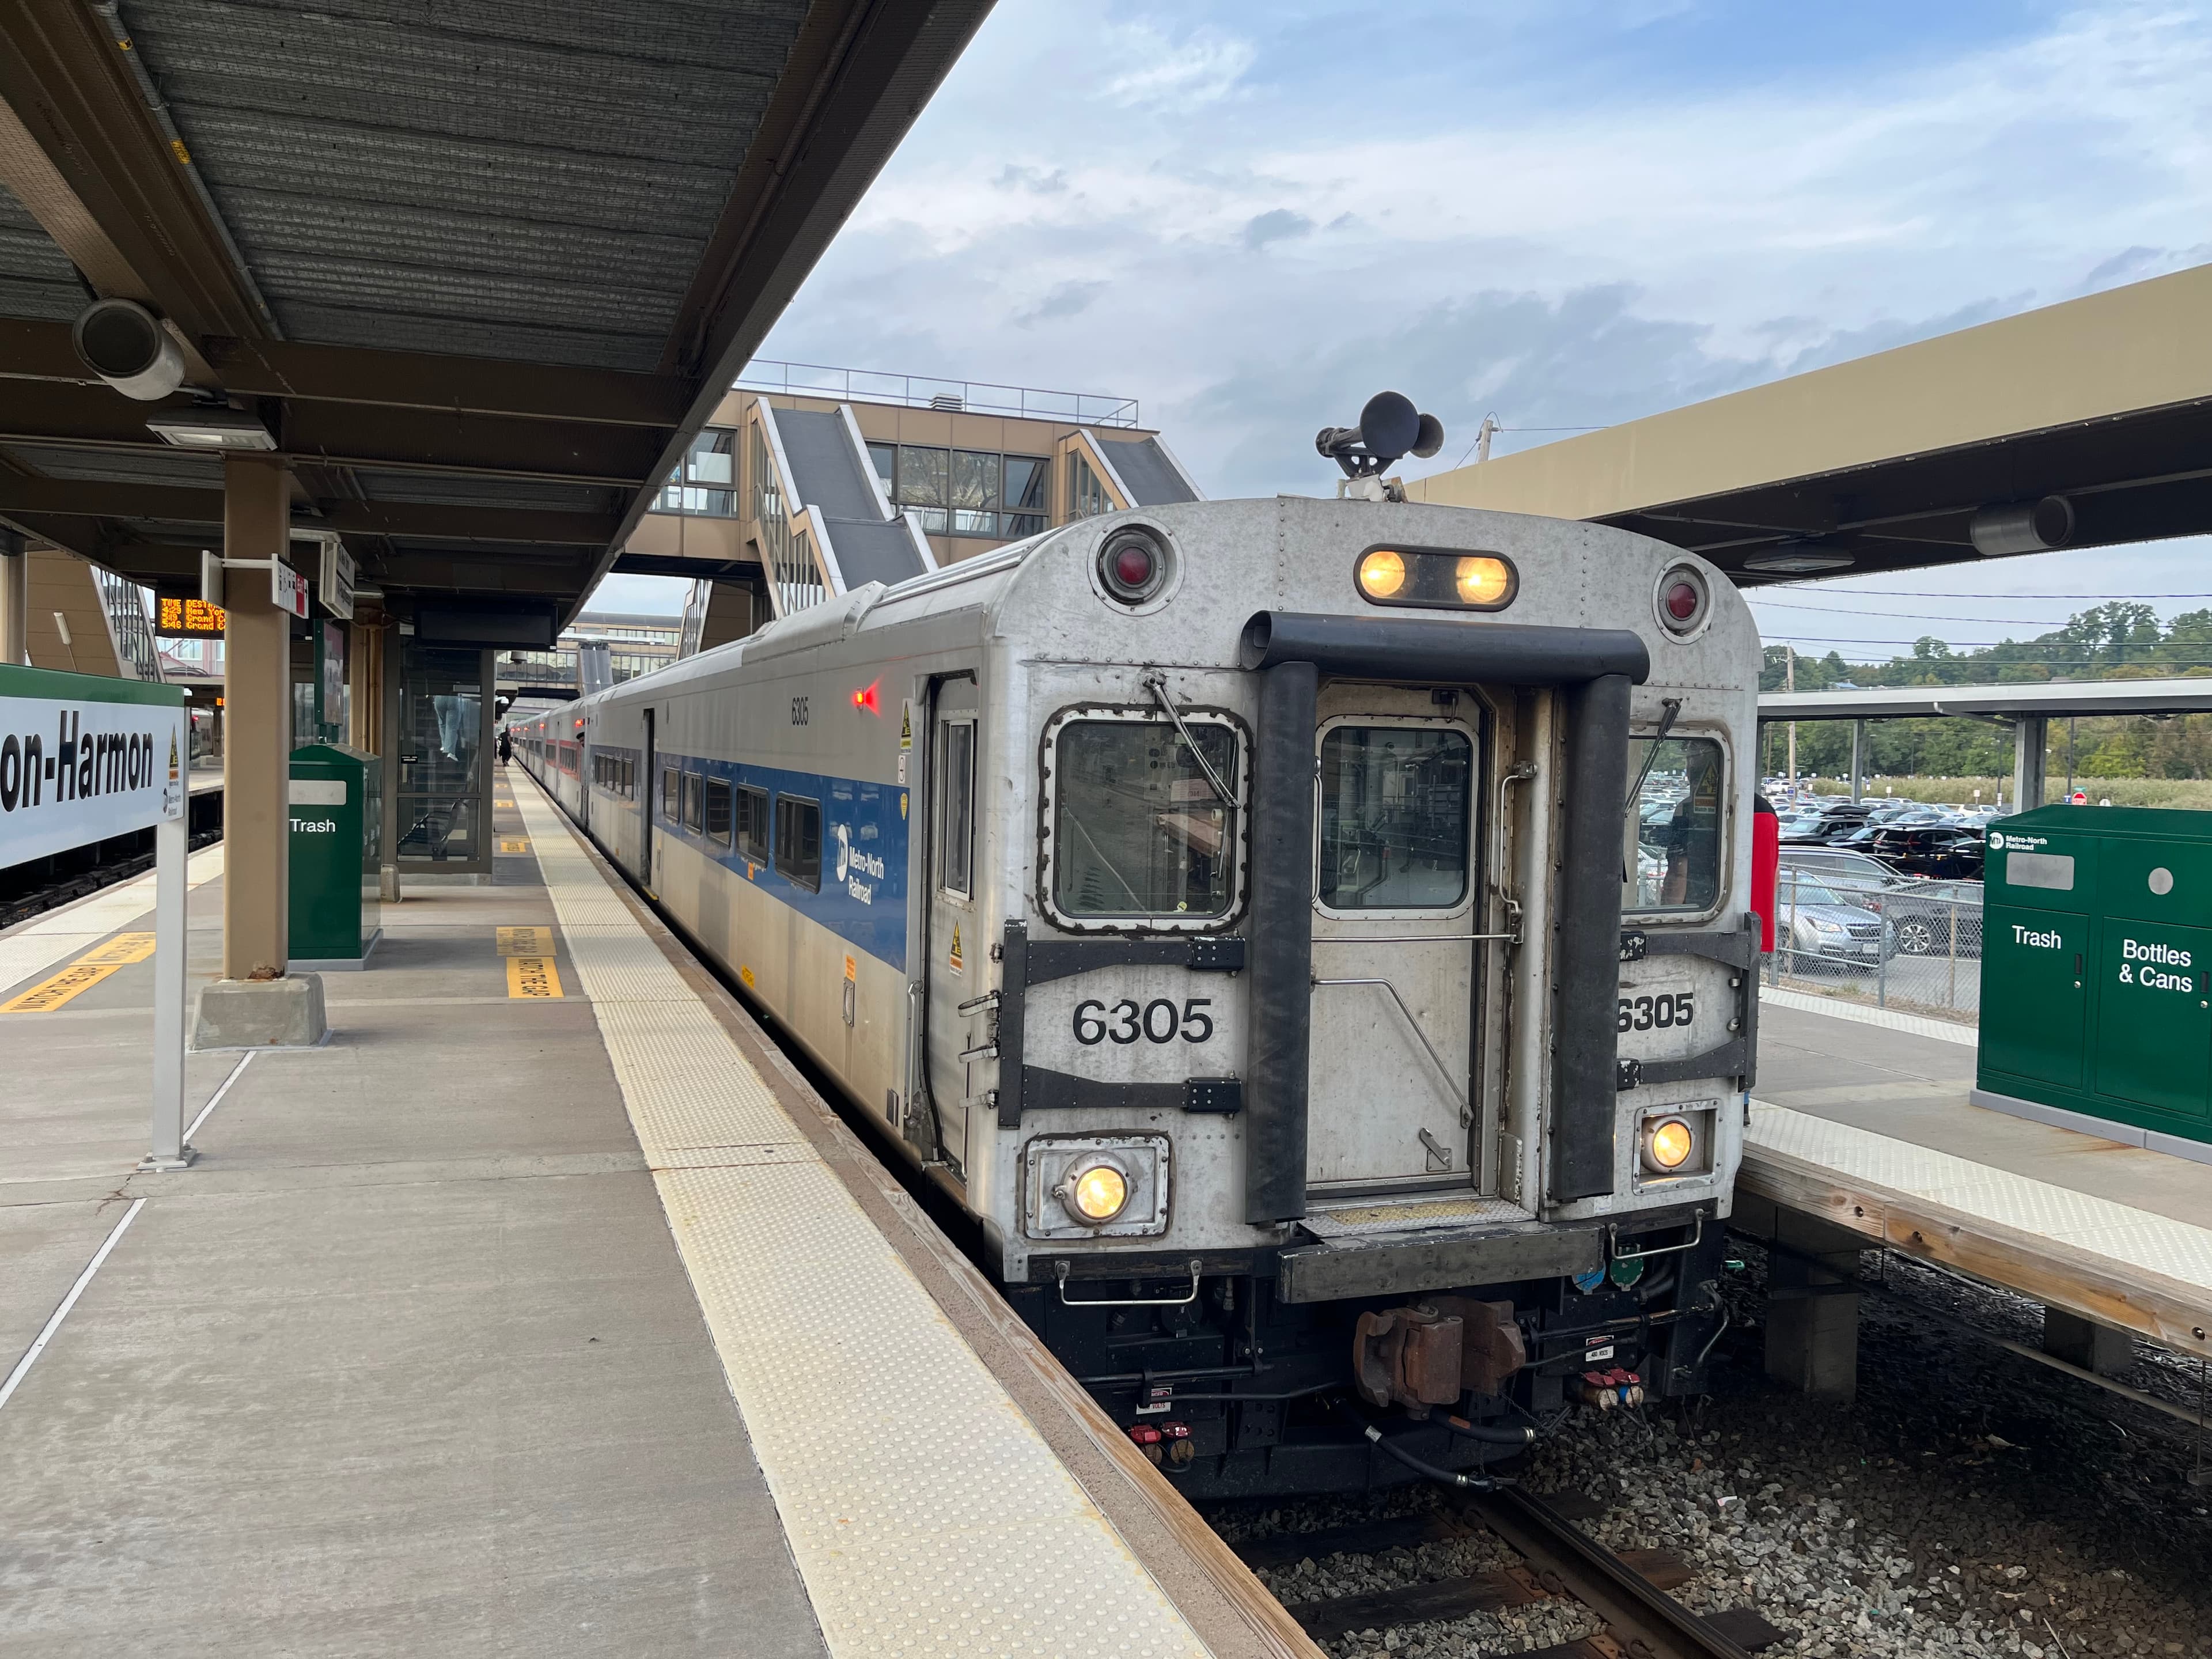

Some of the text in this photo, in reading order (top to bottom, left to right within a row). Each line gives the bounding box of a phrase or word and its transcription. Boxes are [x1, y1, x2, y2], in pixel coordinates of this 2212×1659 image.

[161, 599, 181, 607] TIME
[162, 621, 182, 629] 5:46
[186, 615, 214, 623] Grand
[792, 696, 809, 726] 6305
[0, 710, 154, 812] on-Harmon
[289, 819, 336, 832] Trash
[2005, 835, 2047, 845] Metro-North
[2005, 842, 2035, 850] Railroad
[849, 846, 884, 880] Metro-North
[849, 874, 872, 905] Railroad
[2012, 925, 2062, 949] Trash
[2123, 938, 2192, 967] Bottles
[518, 959, 550, 997] WATCH THE GAP
[2119, 963, 2193, 993] & Cans
[1073, 998, 1213, 1045] 6305
[1618, 992, 1694, 1033] 6305
